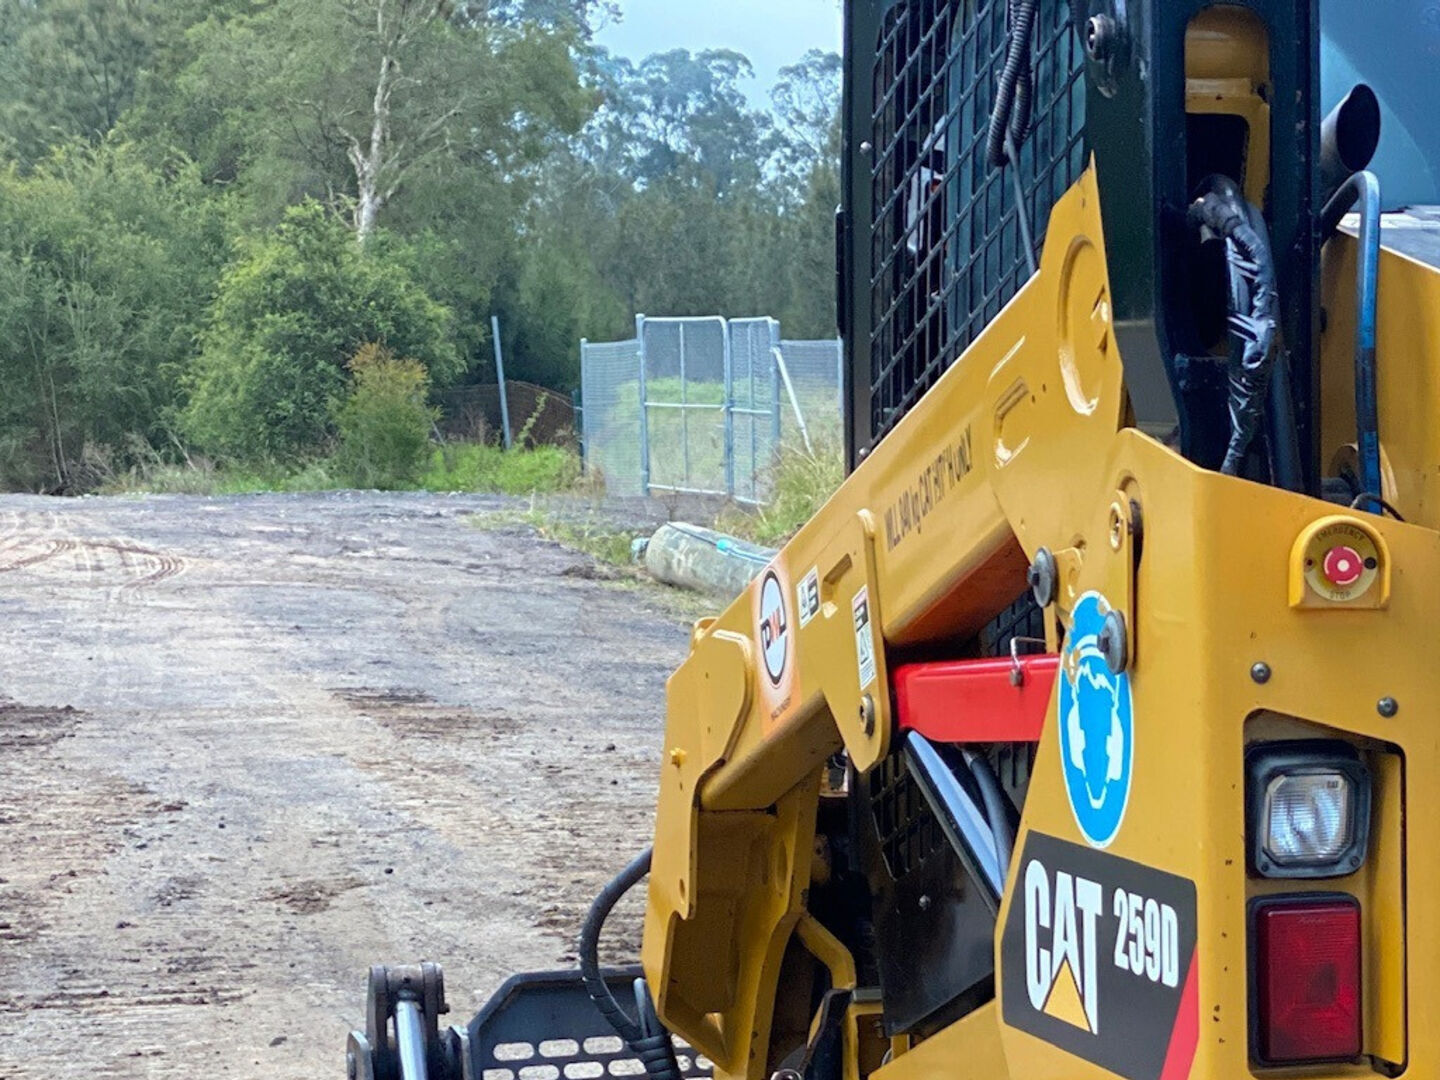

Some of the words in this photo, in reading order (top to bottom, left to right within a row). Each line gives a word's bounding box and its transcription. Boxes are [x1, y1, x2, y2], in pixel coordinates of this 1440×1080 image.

[1316, 526, 1366, 541] EMERGENCY
[1330, 590, 1352, 600] STOP
[1025, 859, 1103, 1036] CAT
[1113, 887, 1180, 988] 259D
